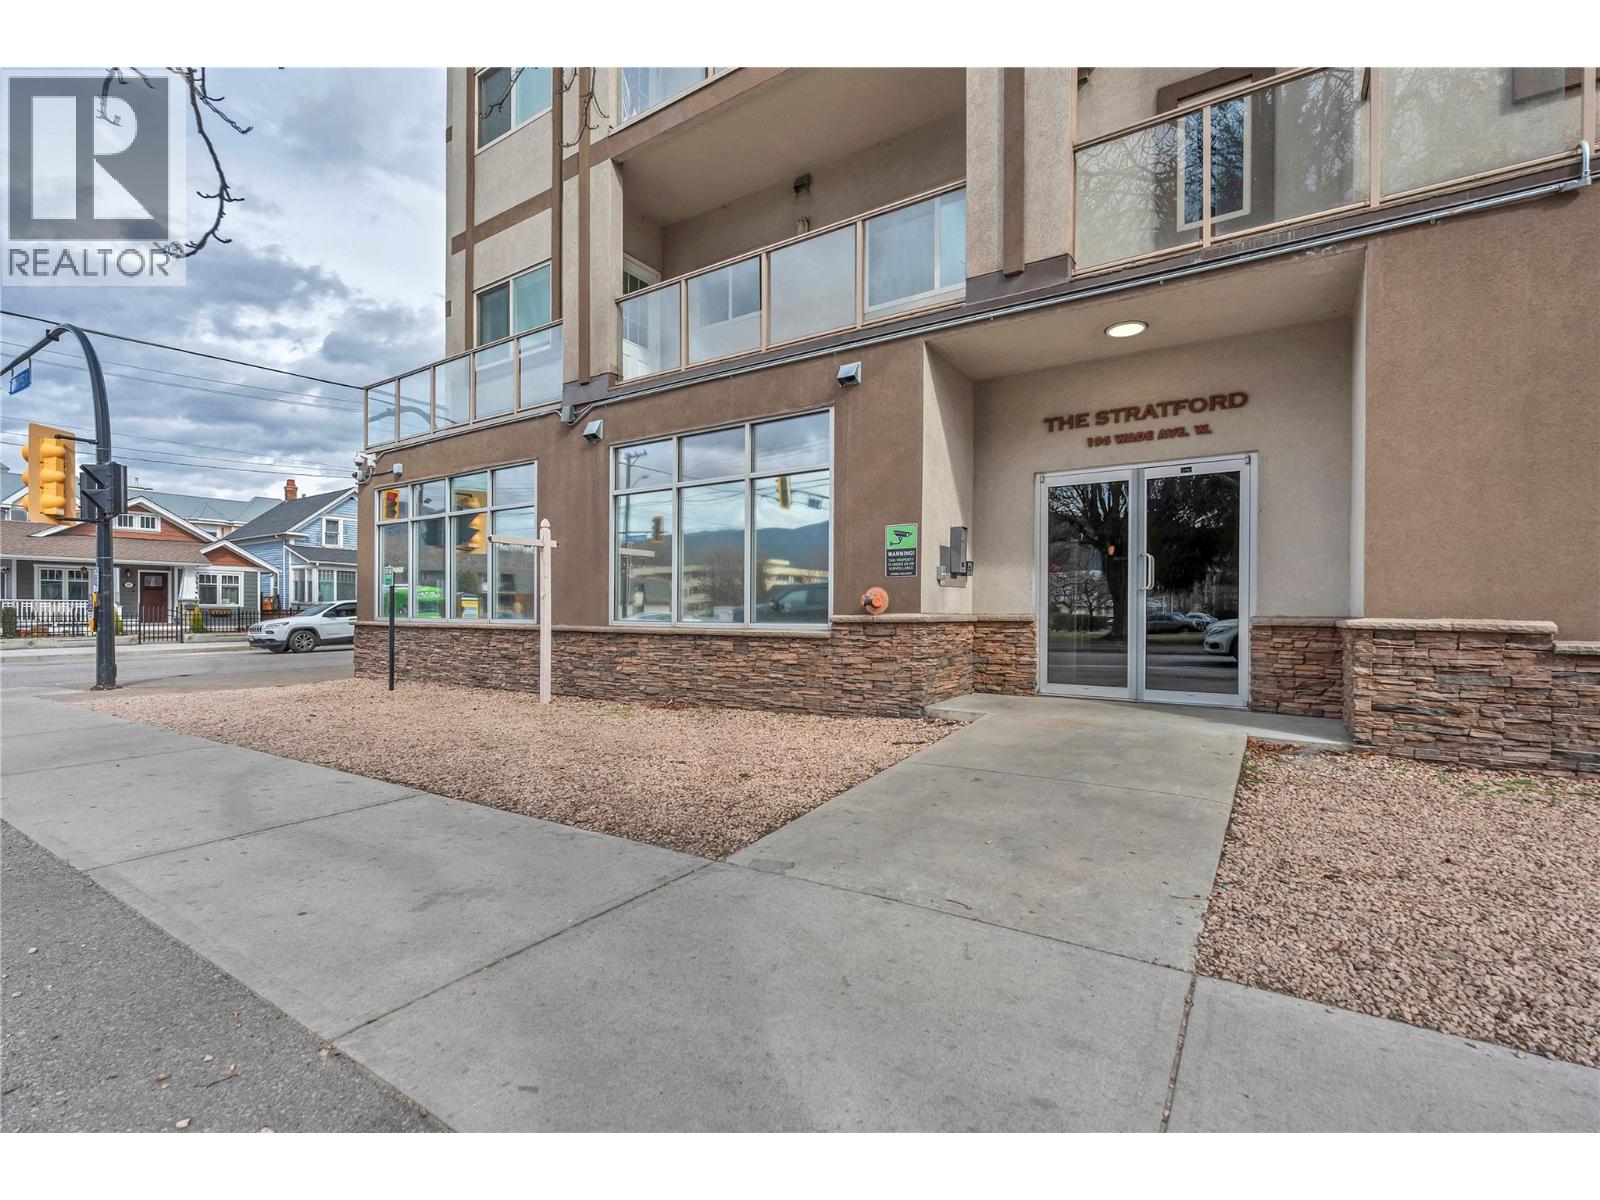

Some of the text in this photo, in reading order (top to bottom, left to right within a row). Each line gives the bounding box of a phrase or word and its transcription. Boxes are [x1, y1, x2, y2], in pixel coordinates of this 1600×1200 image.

[1044, 391, 1249, 433] THE STRATFORD
[1113, 430, 1154, 445] WADE
[1157, 426, 1190, 440] AVE.
